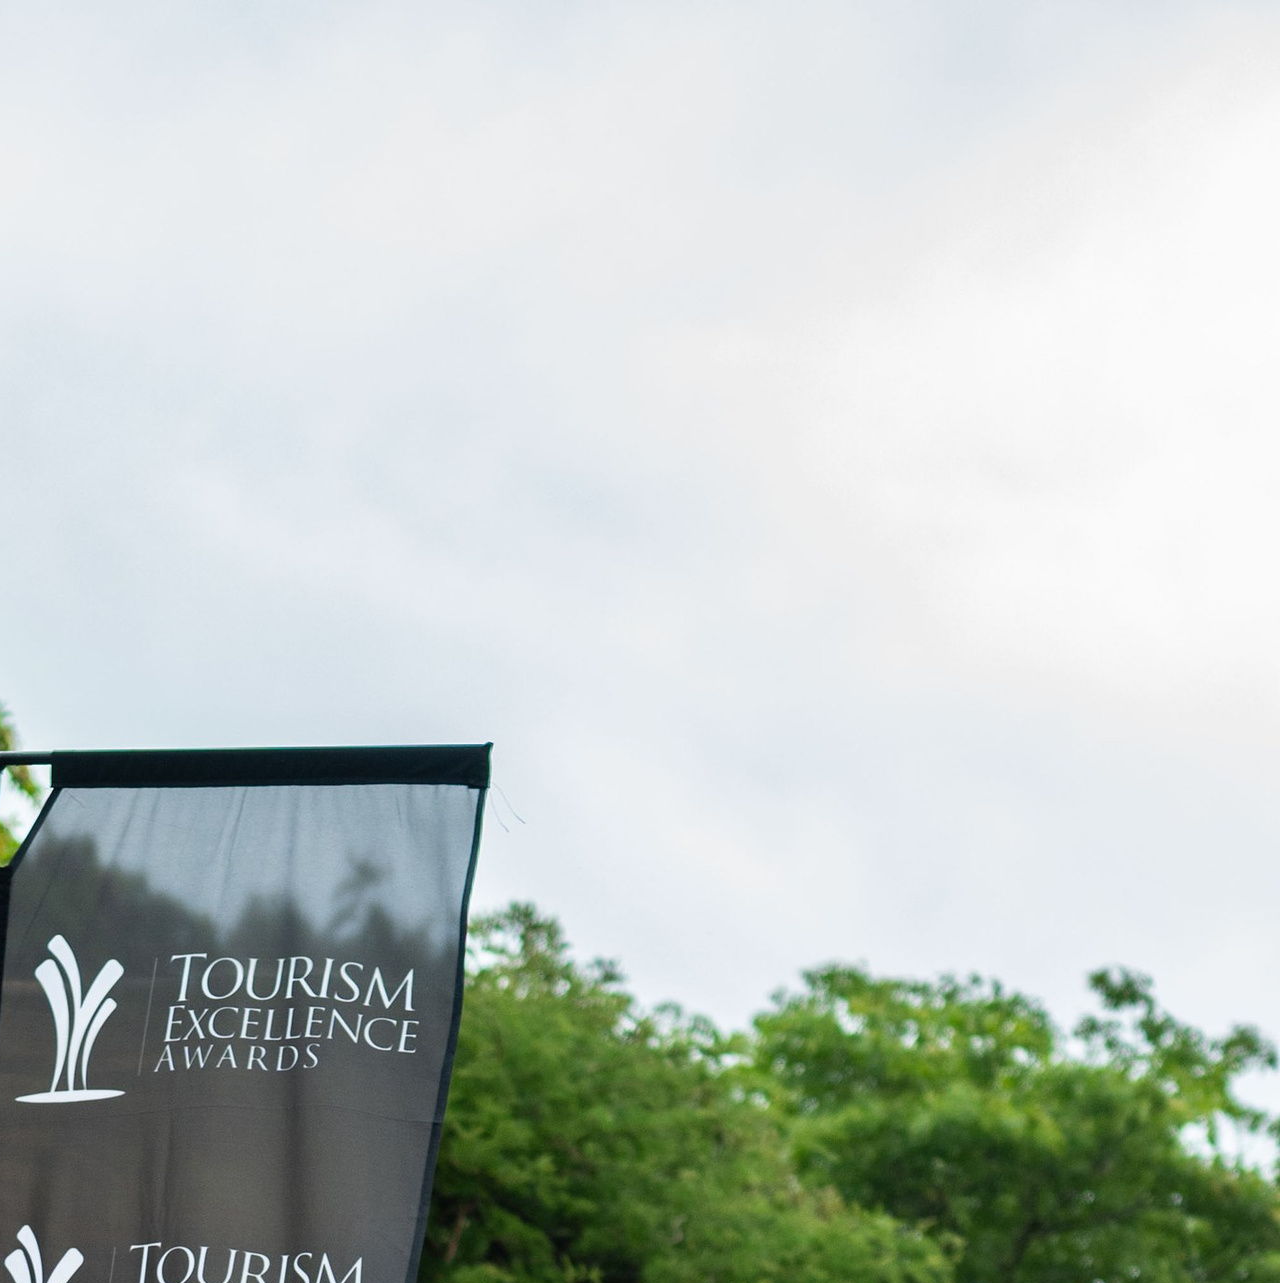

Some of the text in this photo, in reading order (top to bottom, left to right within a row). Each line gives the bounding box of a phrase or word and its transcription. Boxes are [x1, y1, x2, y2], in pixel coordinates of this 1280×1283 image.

[171, 953, 416, 1012] TOURISM
[164, 1005, 420, 1054] EXCELLENCE
[153, 1043, 321, 1073] AWARDS
